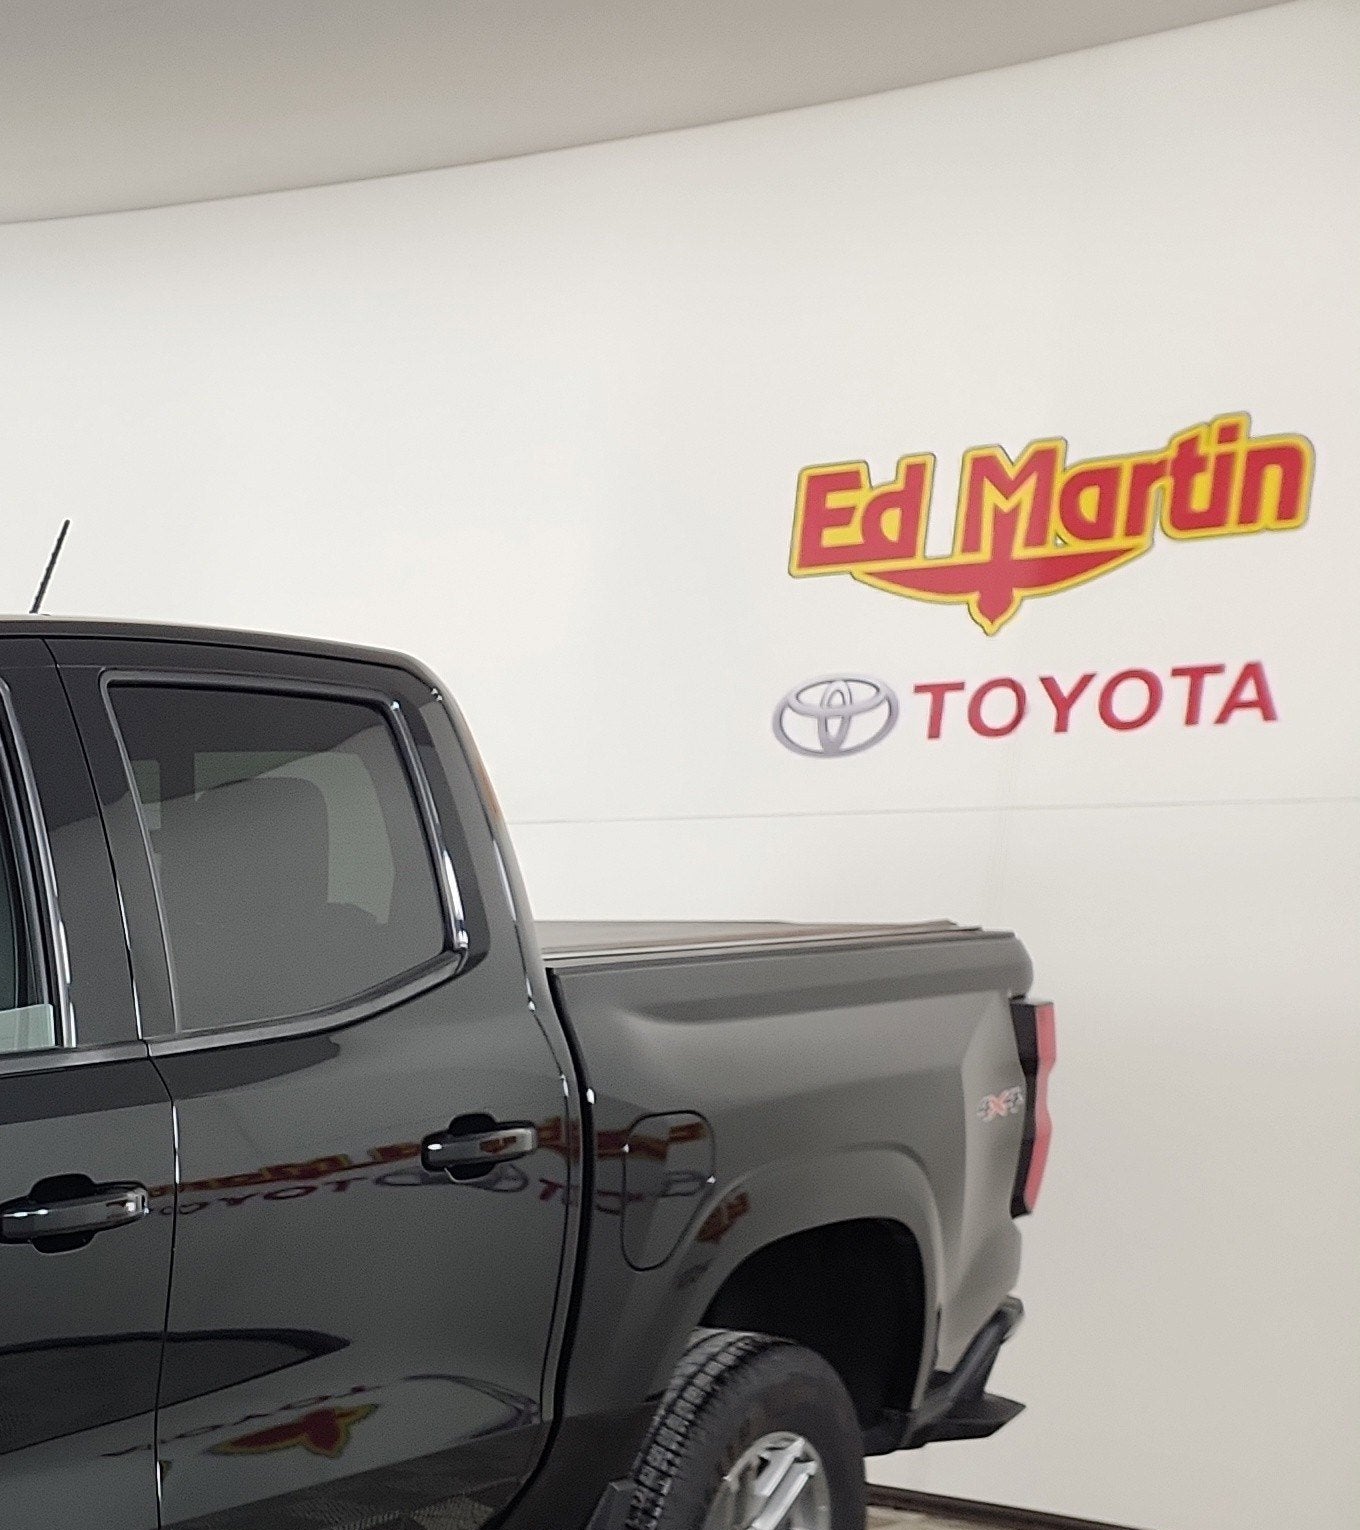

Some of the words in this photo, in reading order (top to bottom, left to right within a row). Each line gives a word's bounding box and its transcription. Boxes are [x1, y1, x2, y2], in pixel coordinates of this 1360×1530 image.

[794, 459, 933, 572] Ed
[960, 419, 1309, 556] Martin
[915, 661, 1278, 740] TOYOTA
